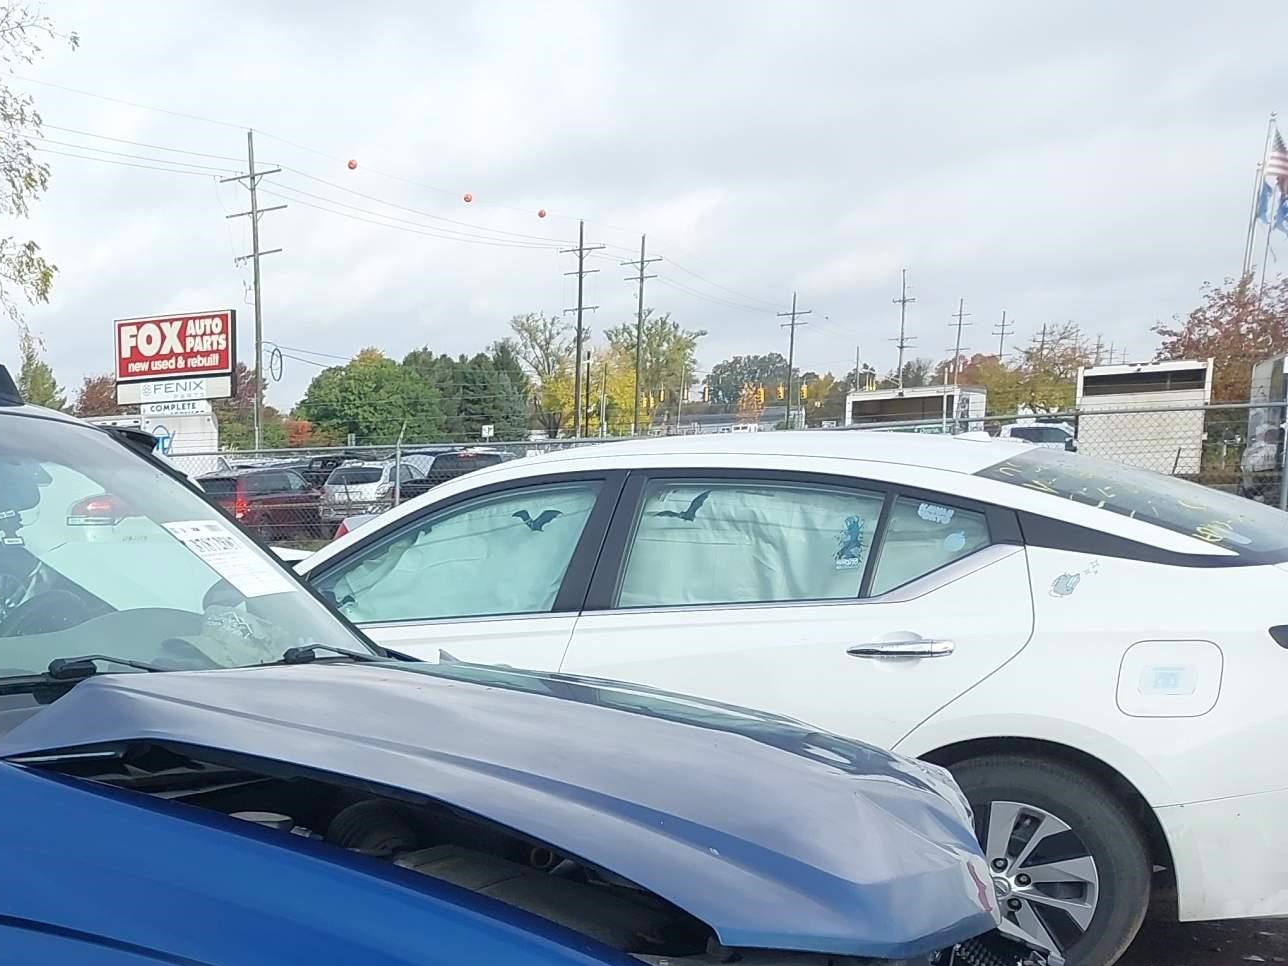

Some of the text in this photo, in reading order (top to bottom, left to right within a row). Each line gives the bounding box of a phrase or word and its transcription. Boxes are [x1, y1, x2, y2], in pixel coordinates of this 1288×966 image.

[185, 317, 223, 335] AUTO
[120, 320, 184, 358] FOX
[185, 333, 227, 353] PARTS
[128, 353, 220, 373] new used & rebuilt
[153, 380, 205, 395] FENIX
[150, 402, 197, 412] COMPLETE
